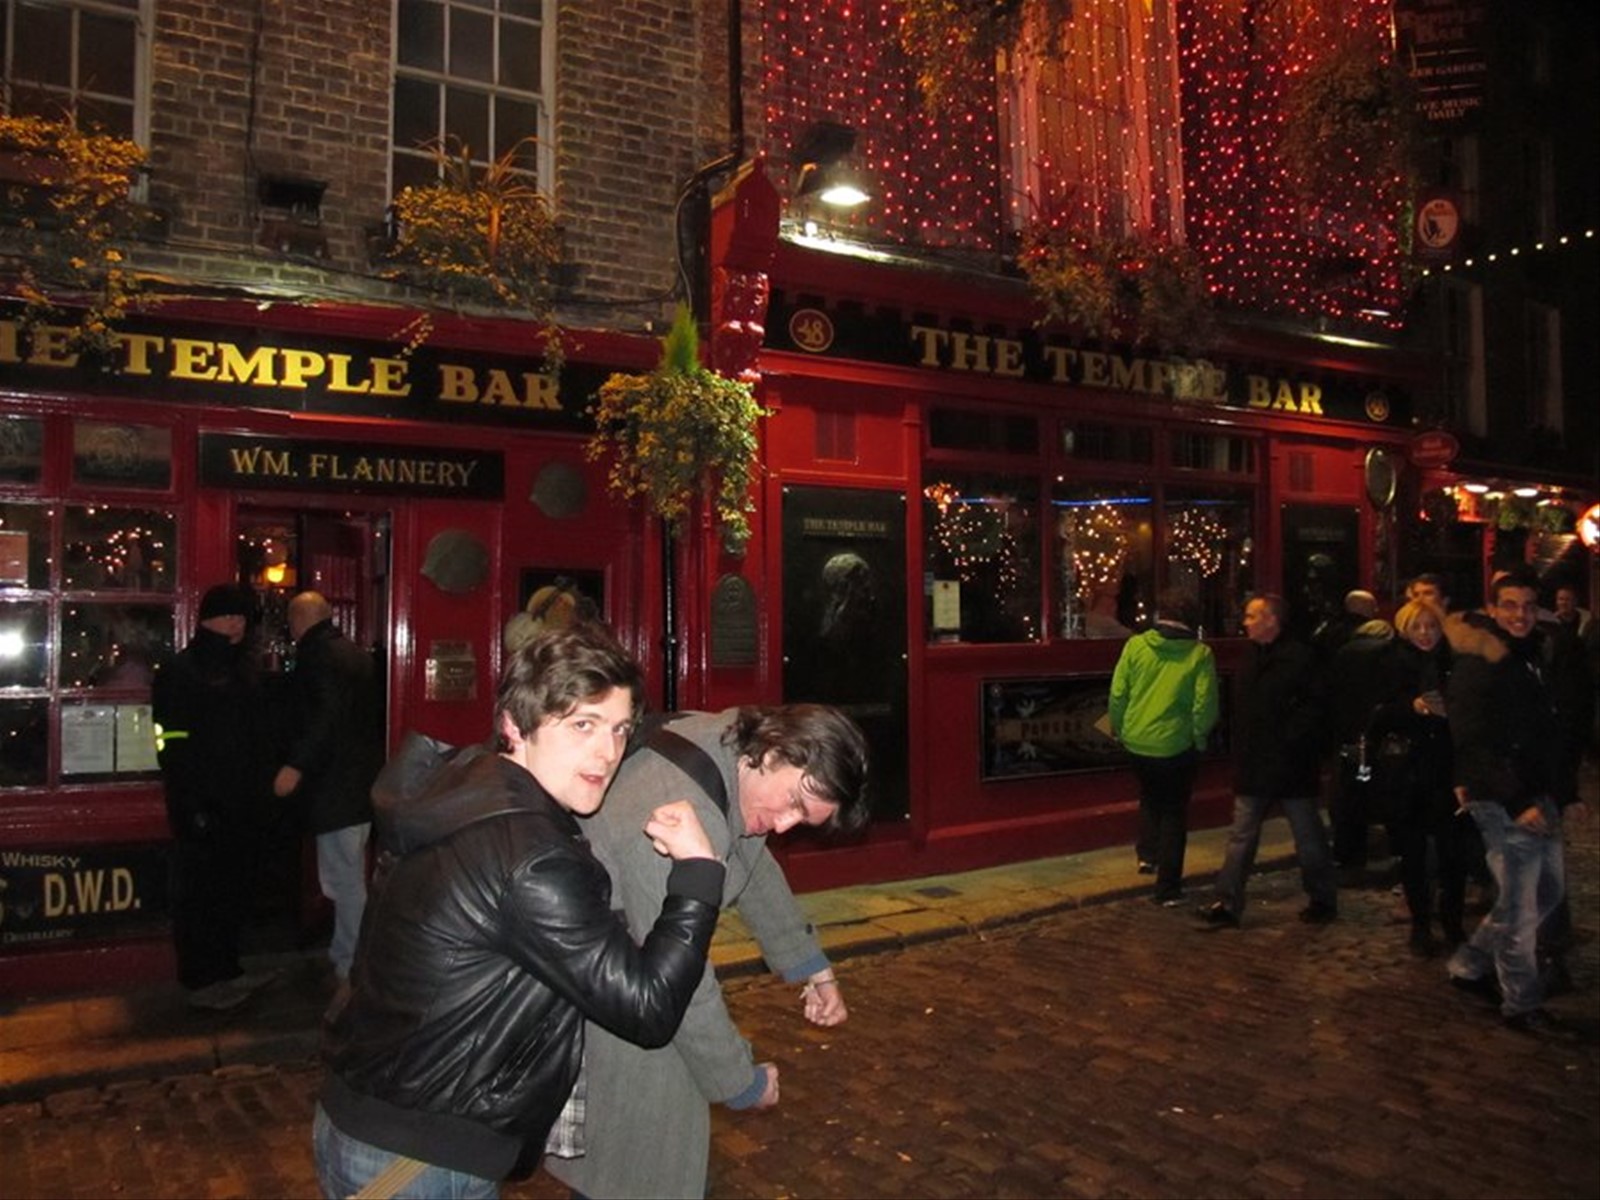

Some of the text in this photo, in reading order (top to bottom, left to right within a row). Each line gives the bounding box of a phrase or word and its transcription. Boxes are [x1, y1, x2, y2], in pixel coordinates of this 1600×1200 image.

[1427, 107, 1466, 121] DAILY
[116, 334, 413, 398] TEMPLE
[438, 363, 564, 411] BAR
[911, 324, 1025, 378] THE
[1248, 374, 1325, 416] BAR
[231, 446, 478, 488] WM. FLANNERY
[44, 867, 142, 917] D.W.D.
